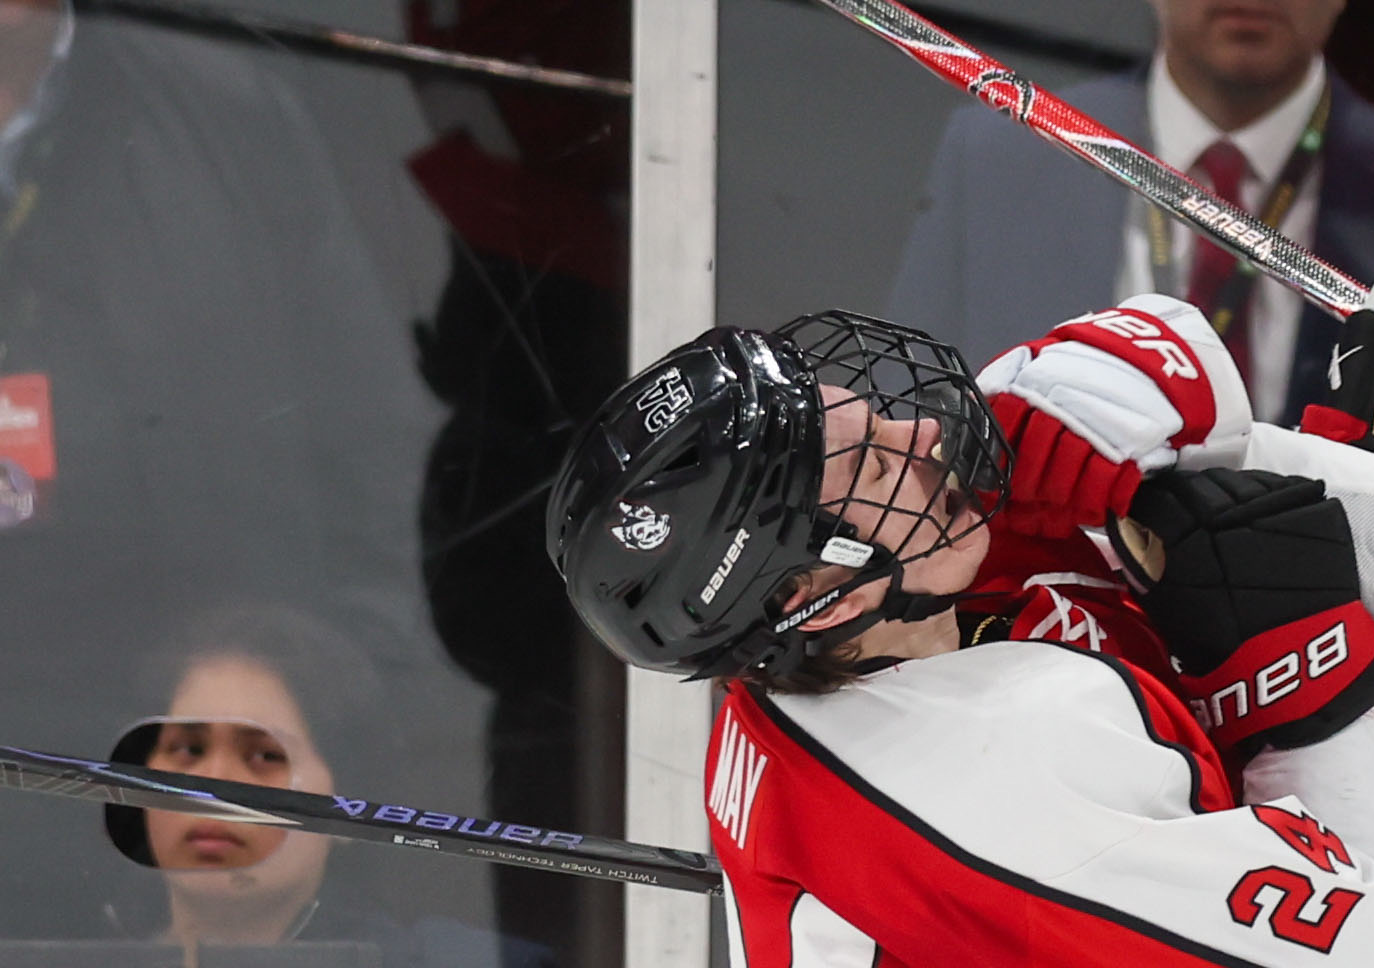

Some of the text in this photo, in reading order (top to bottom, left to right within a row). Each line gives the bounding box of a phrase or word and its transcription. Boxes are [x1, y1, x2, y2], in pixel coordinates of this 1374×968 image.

[700, 528, 751, 605] BAUER
[775, 589, 840, 634] BAUER
[708, 706, 768, 850] MAY
[373, 803, 585, 850] BAUER
[560, 862, 603, 875] TAPER
[608, 869, 659, 885] TWITCH
[1226, 804, 1365, 955] 24
